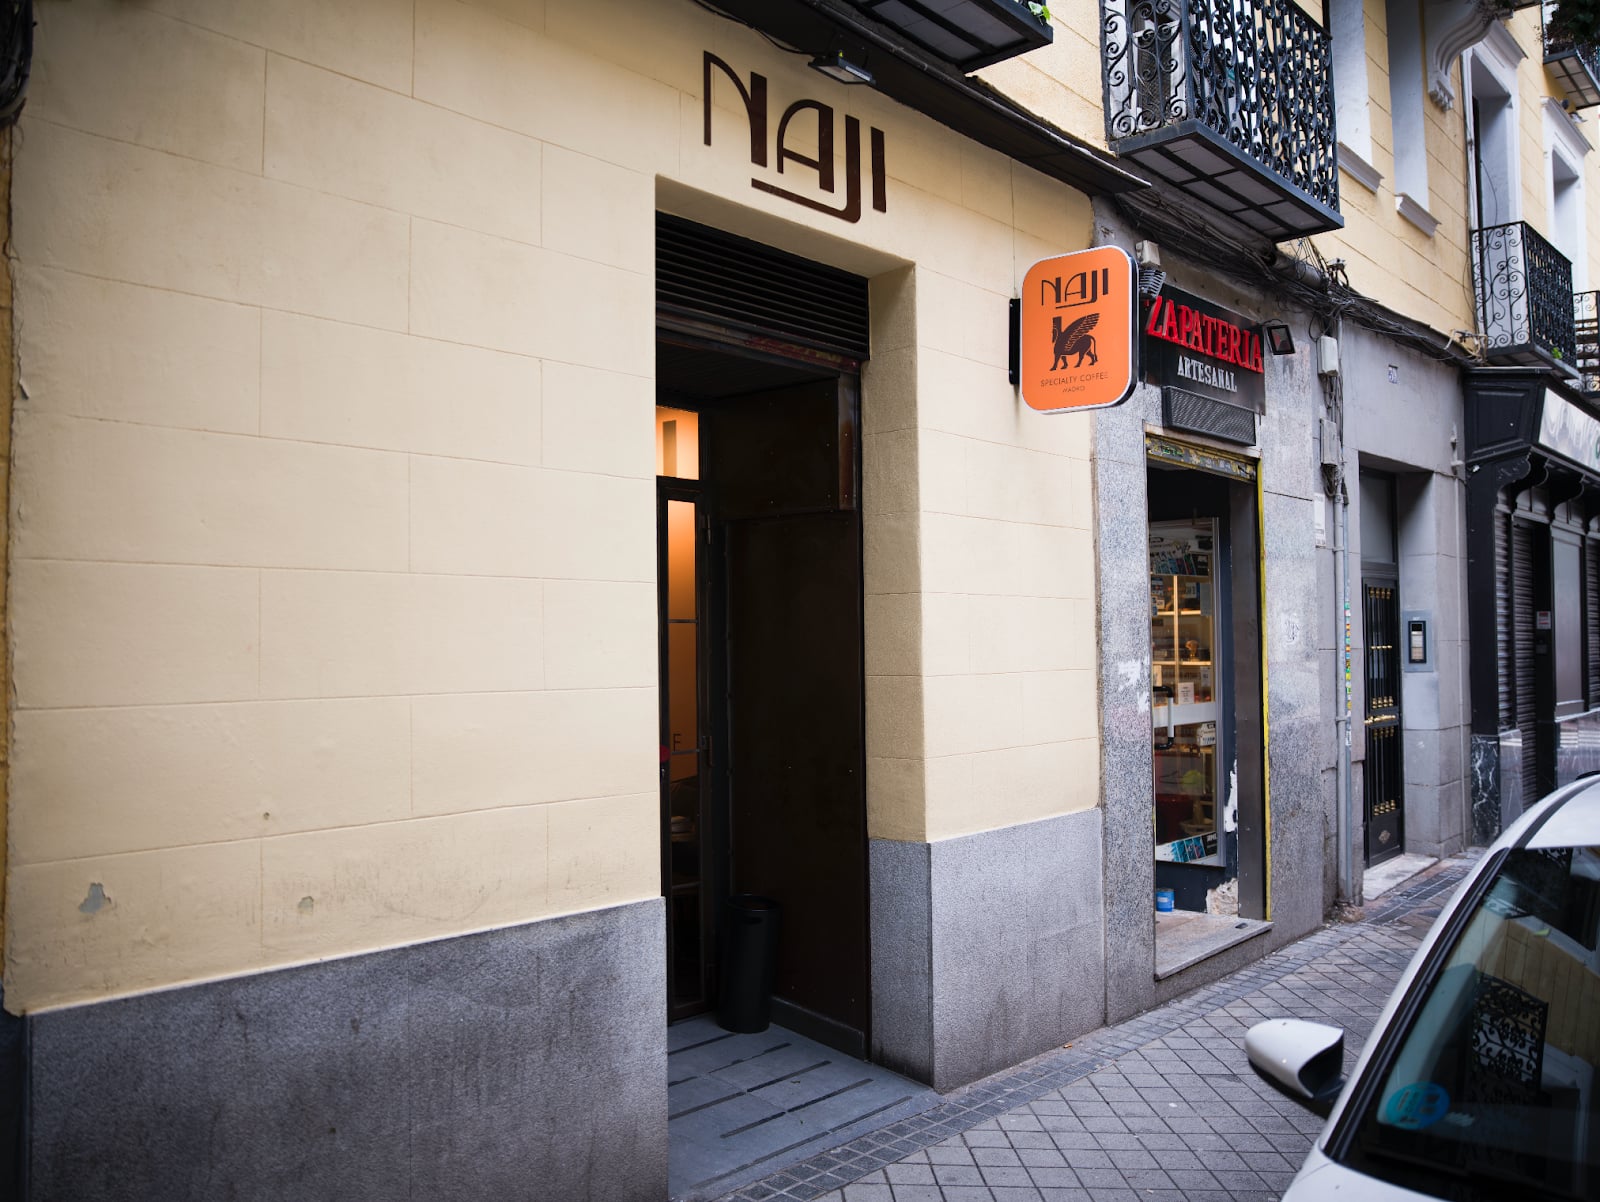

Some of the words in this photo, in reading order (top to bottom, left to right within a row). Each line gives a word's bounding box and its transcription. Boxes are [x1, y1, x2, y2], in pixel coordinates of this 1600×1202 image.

[703, 50, 887, 224] NAJI
[1041, 268, 1108, 309] NAJI
[1144, 295, 1264, 374] ZAPATERIA
[1040, 375, 1078, 388] SPECIALTY
[1079, 371, 1109, 383] COFFEE
[1062, 385, 1086, 393] MADRID
[1177, 354, 1238, 393] ARTESANAL
